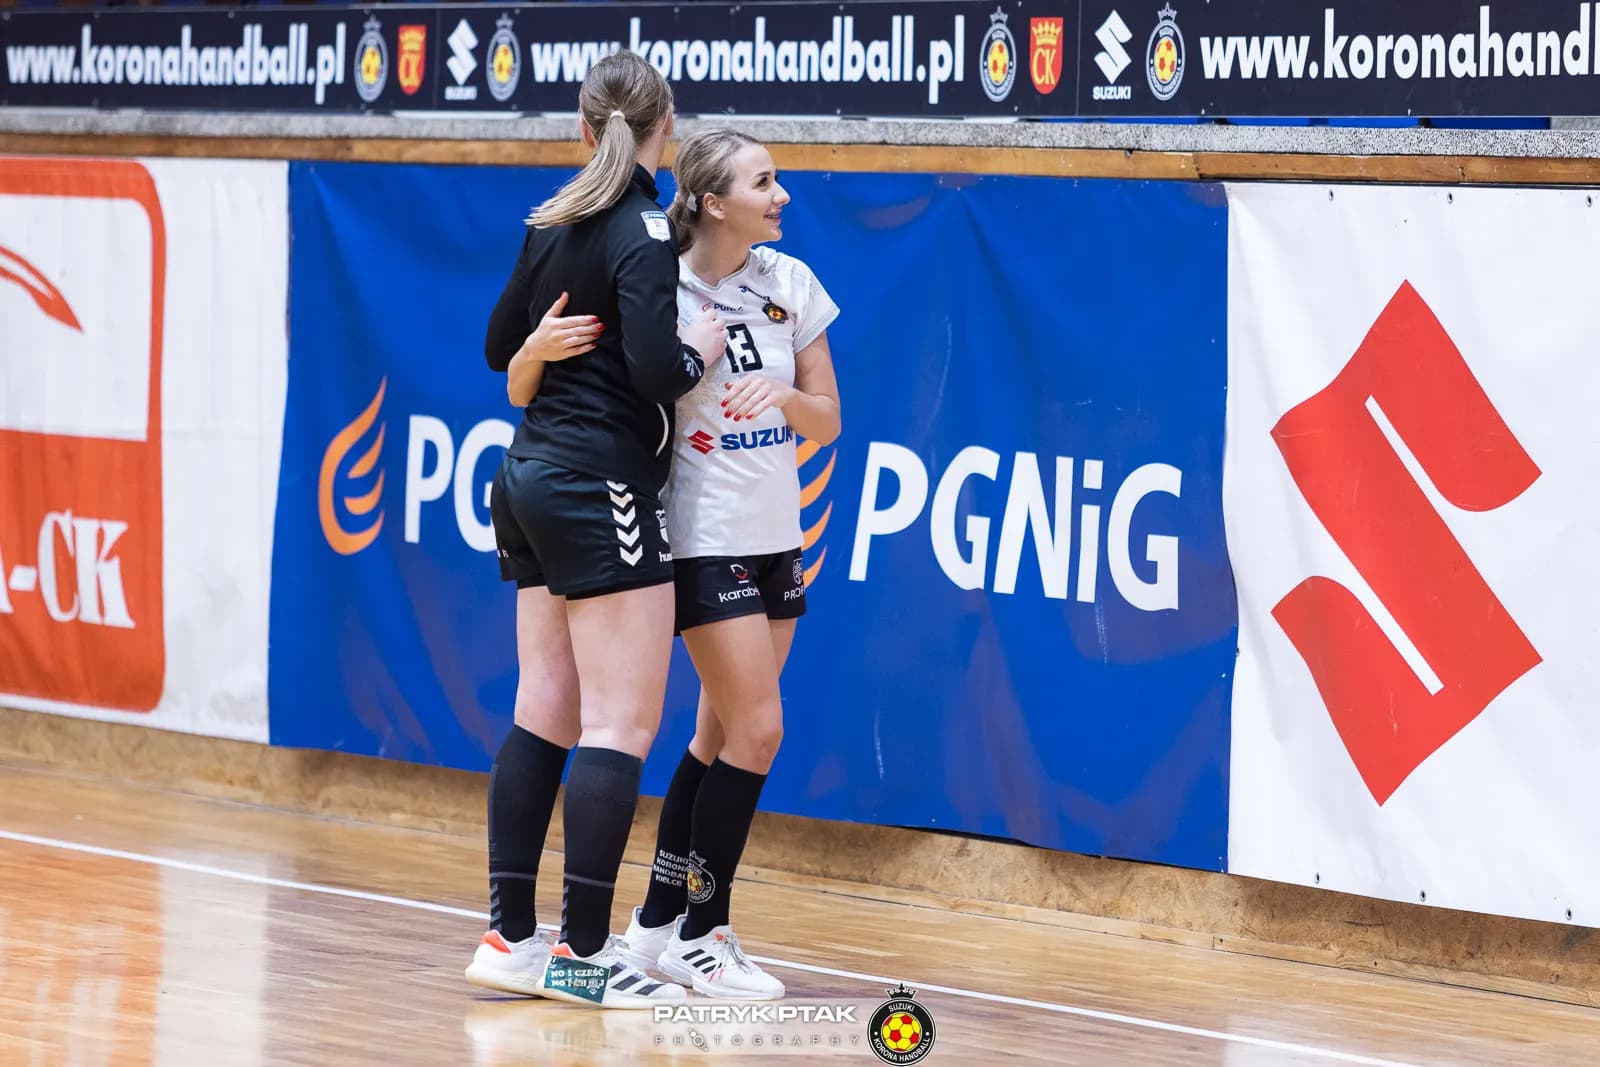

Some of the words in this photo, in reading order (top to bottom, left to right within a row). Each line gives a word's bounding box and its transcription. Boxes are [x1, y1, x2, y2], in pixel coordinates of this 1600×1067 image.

[1200, 2, 1600, 79] www.koronahand
[6, 23, 346, 105] www.koronahandball.pl
[1032, 47, 1057, 85] CK
[1092, 86, 1132, 100] SUZUKI
[725, 323, 763, 373] 13
[720, 425, 793, 451] SUZUK
[849, 441, 1182, 611] PGNiG
[659, 849, 689, 864] SUZUKI
[653, 864, 687, 880] HANDBAL
[656, 857, 690, 873] KORONA
[655, 874, 683, 887] KIELCE
[550, 969, 565, 978] NO
[575, 967, 605, 977] CZEŚĆ
[551, 979, 566, 987] NO
